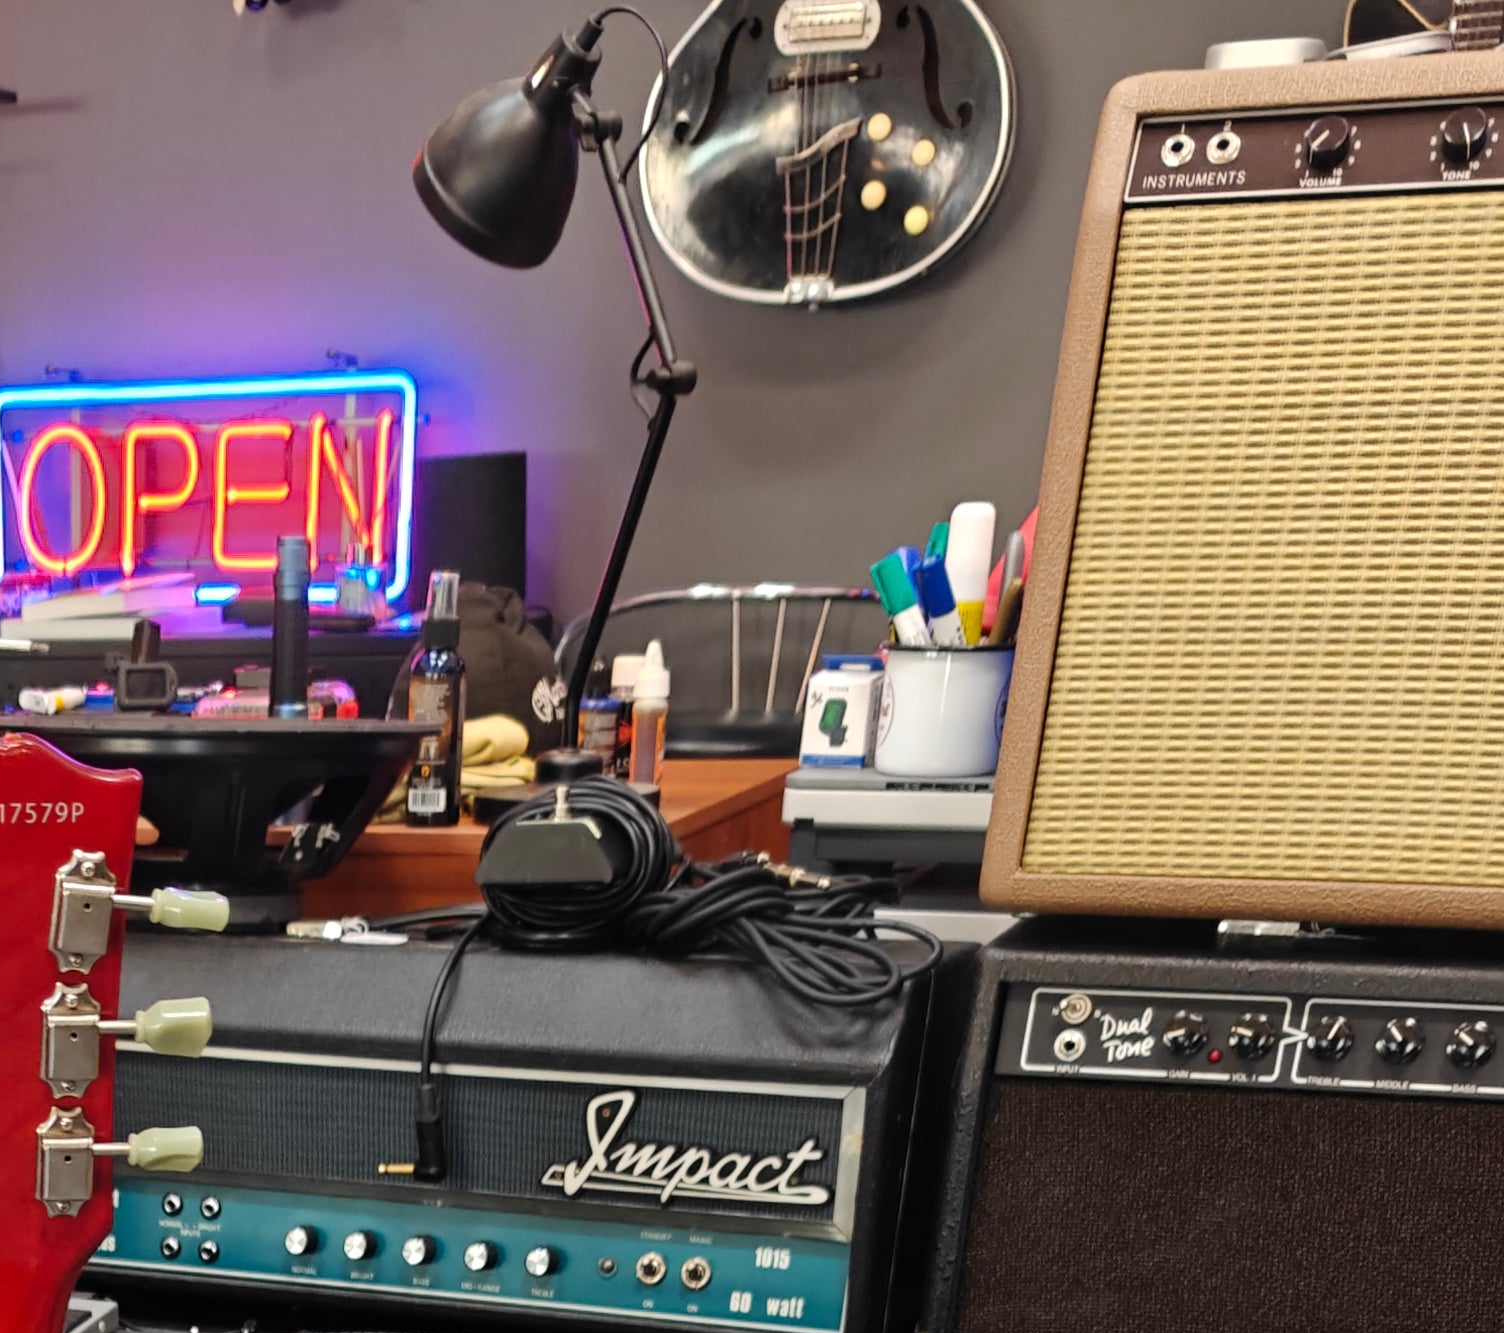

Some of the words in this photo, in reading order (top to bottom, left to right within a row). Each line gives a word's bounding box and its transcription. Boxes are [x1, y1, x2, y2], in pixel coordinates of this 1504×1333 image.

[1142, 169, 1246, 190] INSTRUMENTS
[1298, 176, 1343, 188] VOLUME
[1441, 169, 1472, 181] TONE
[19, 409, 395, 578] OPEN
[1099, 1006, 1153, 1042] Dual
[1102, 1036, 1156, 1064] Tone
[1055, 1064, 1080, 1074] INPUT
[1168, 1069, 1189, 1080] GAIN
[1306, 1075, 1341, 1087] TREBLE
[1375, 1079, 1410, 1090] MIDDLE
[1451, 1083, 1478, 1094] BASS
[548, 1089, 830, 1205] Impact
[755, 1246, 791, 1271] 1015
[766, 1297, 806, 1320] watt
